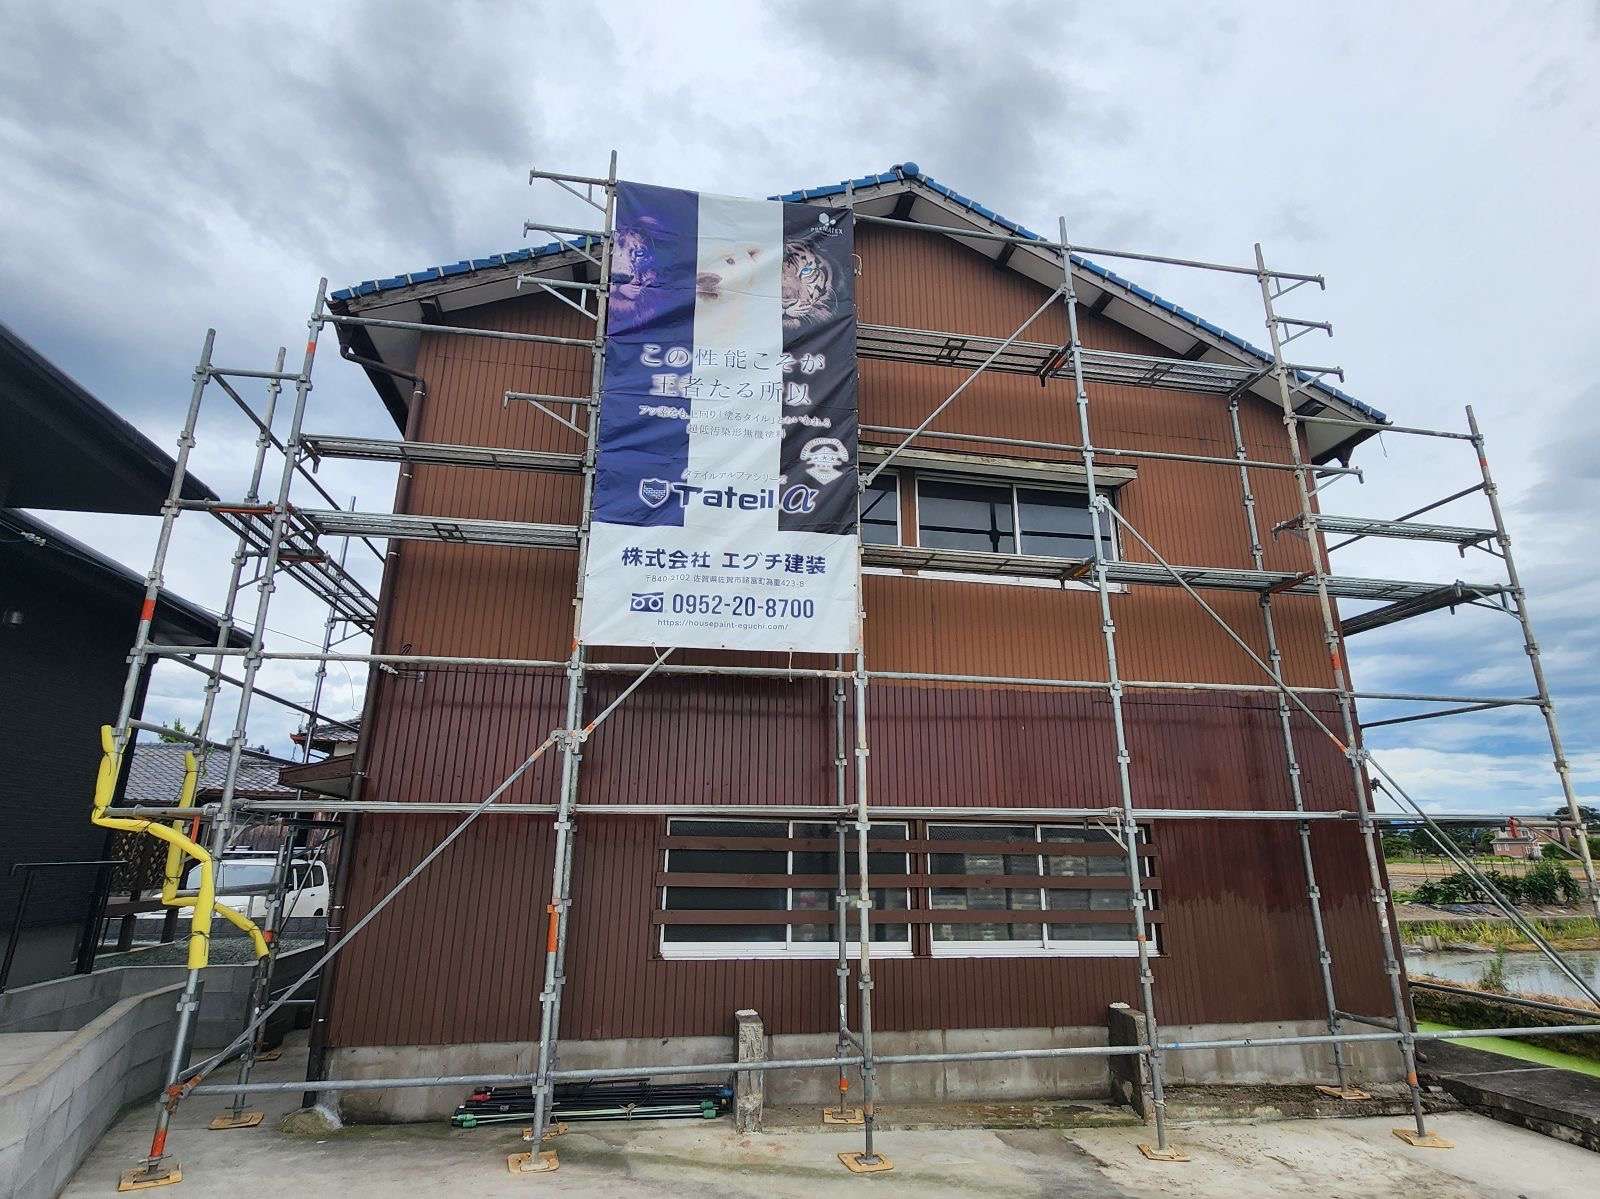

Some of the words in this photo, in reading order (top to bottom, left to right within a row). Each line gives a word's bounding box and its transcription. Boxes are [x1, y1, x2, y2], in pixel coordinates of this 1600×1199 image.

[641, 344, 825, 374] この性能こそが
[652, 373, 812, 405] 王者たる所以
[672, 482, 774, 511] Tateil
[621, 547, 711, 570] 株式会社
[721, 551, 826, 575] エグチ建装
[672, 593, 815, 619] 0952-20-8700
